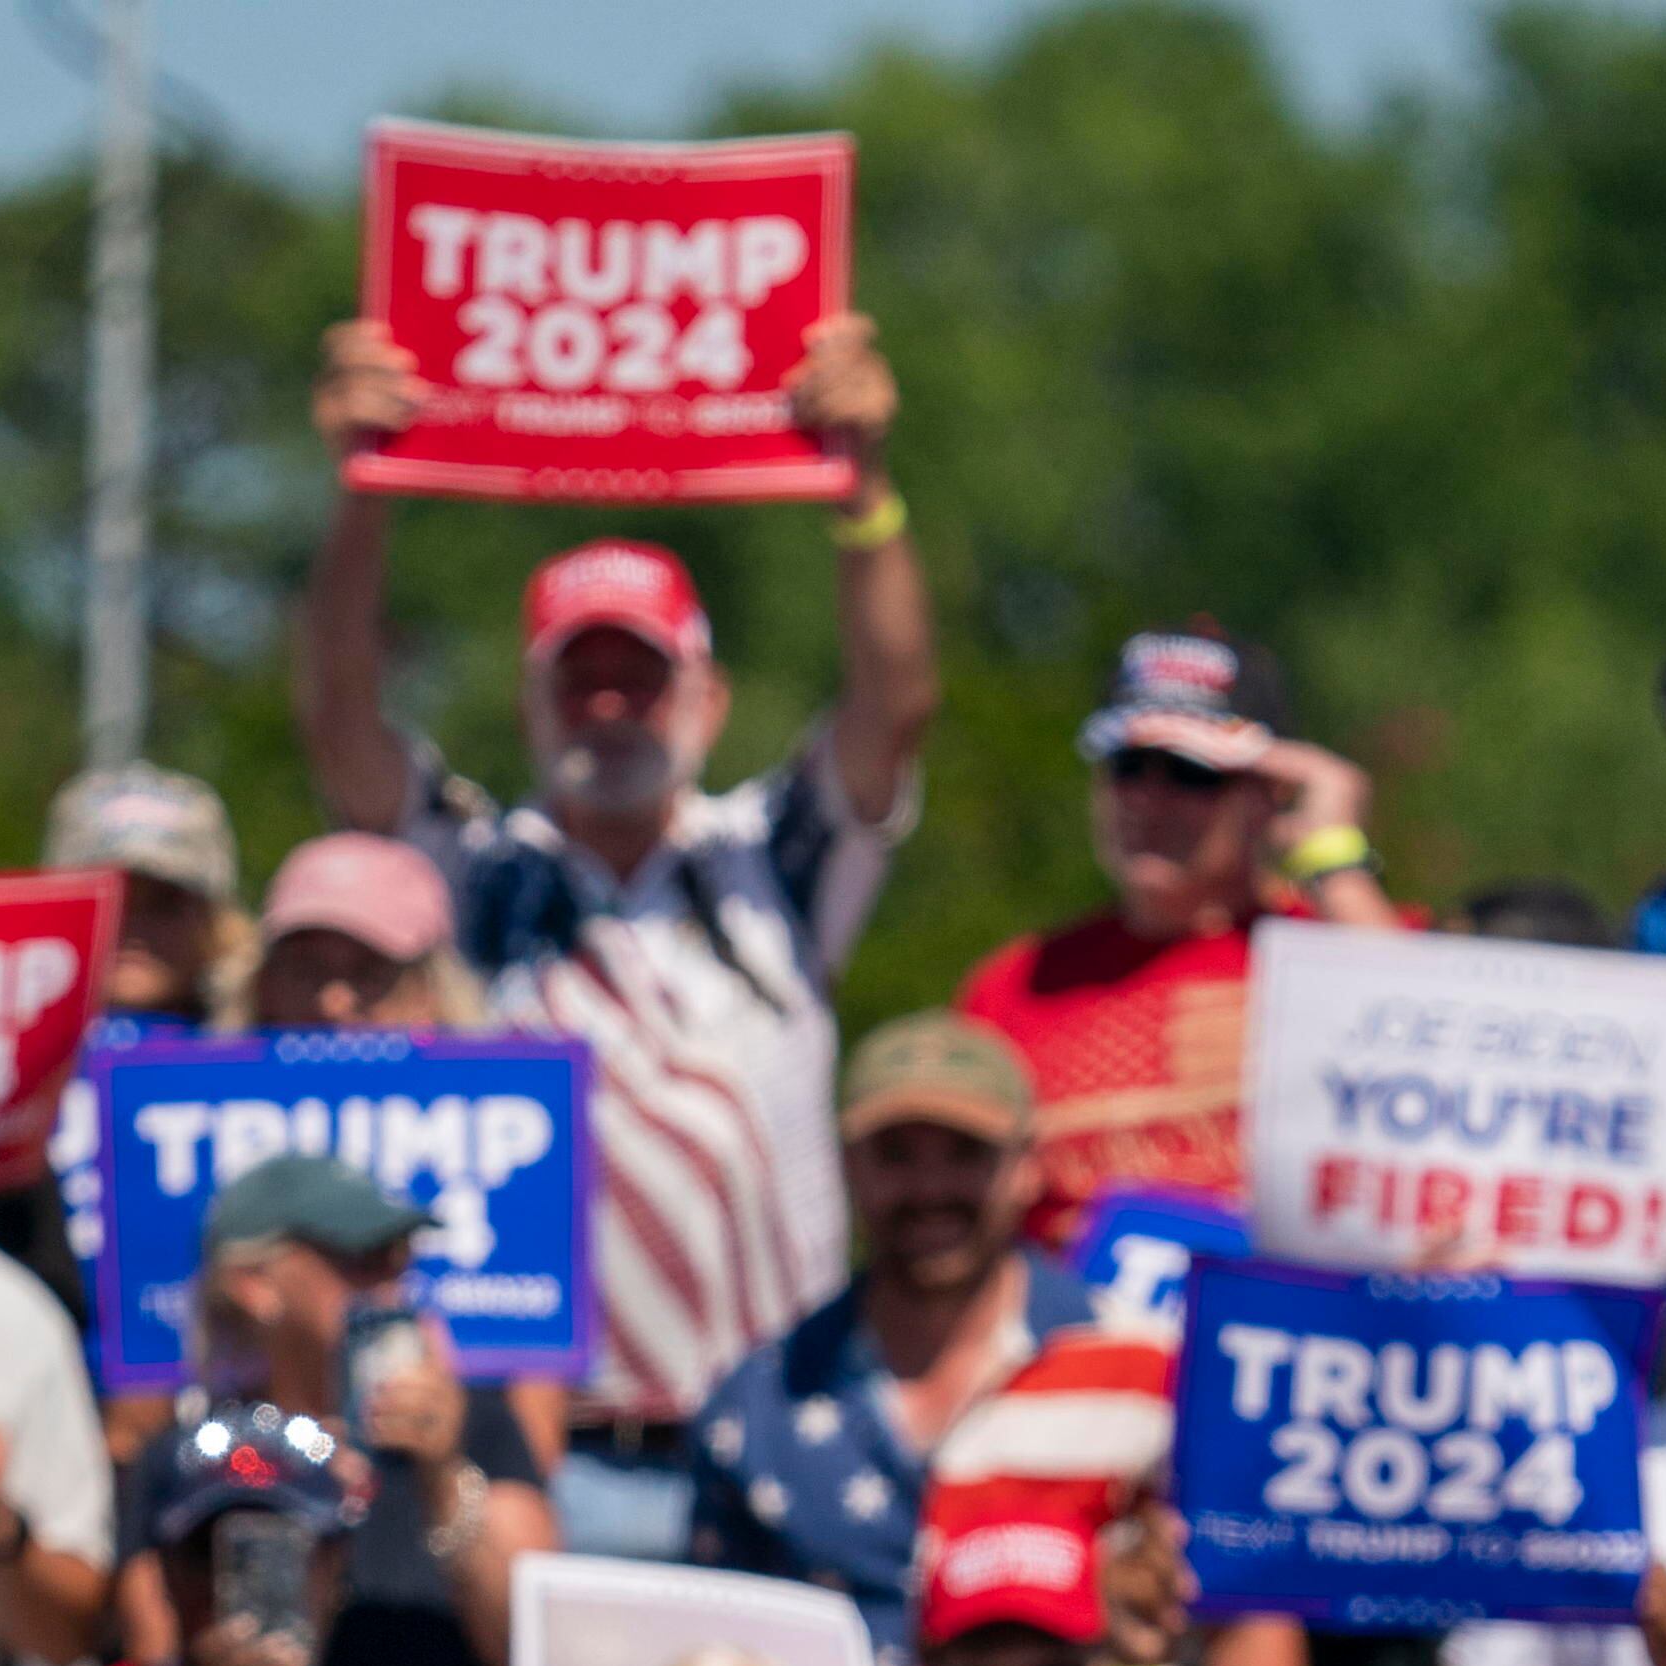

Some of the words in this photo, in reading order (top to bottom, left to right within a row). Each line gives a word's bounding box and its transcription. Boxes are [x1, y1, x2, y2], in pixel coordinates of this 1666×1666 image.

[405, 202, 811, 309] TRUMP
[451, 293, 755, 392] 2024
[1321, 1062, 1655, 1164] YOU'RE
[1309, 1155, 1665, 1258] FIRED!
[1218, 1322, 1617, 1437] TRUMP
[1263, 1419, 1584, 1526] 2024
